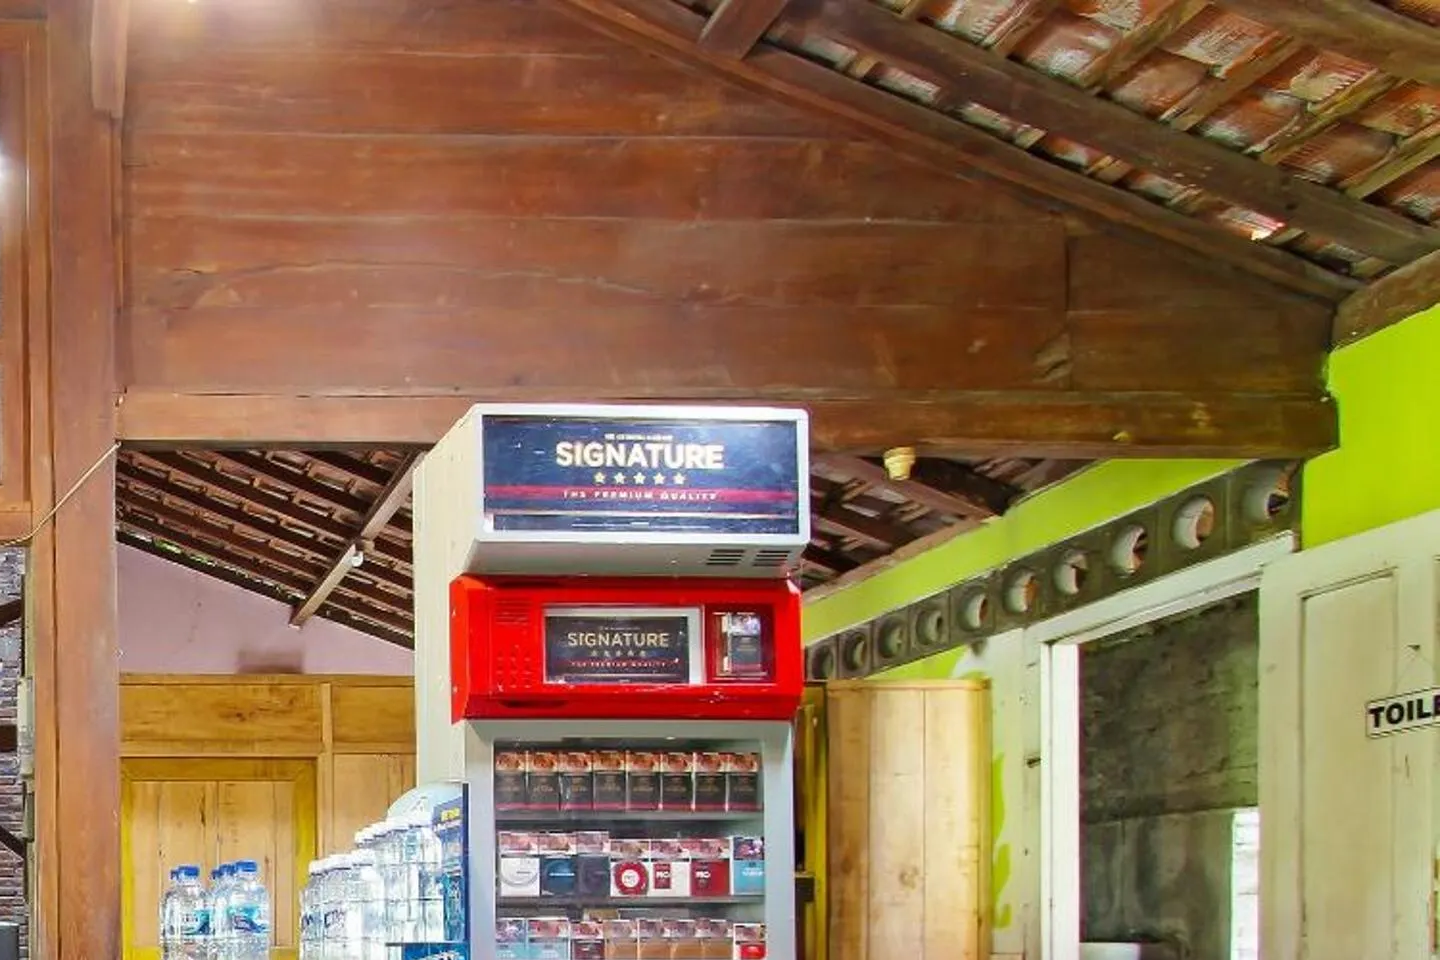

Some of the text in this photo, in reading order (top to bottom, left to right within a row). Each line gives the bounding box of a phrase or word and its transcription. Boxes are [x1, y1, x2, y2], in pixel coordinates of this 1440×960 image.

[555, 440, 725, 469] SIGNATURE
[594, 490, 654, 499] PREMIUM
[660, 490, 718, 500] QUALITY
[567, 632, 670, 648] SIGNATURE
